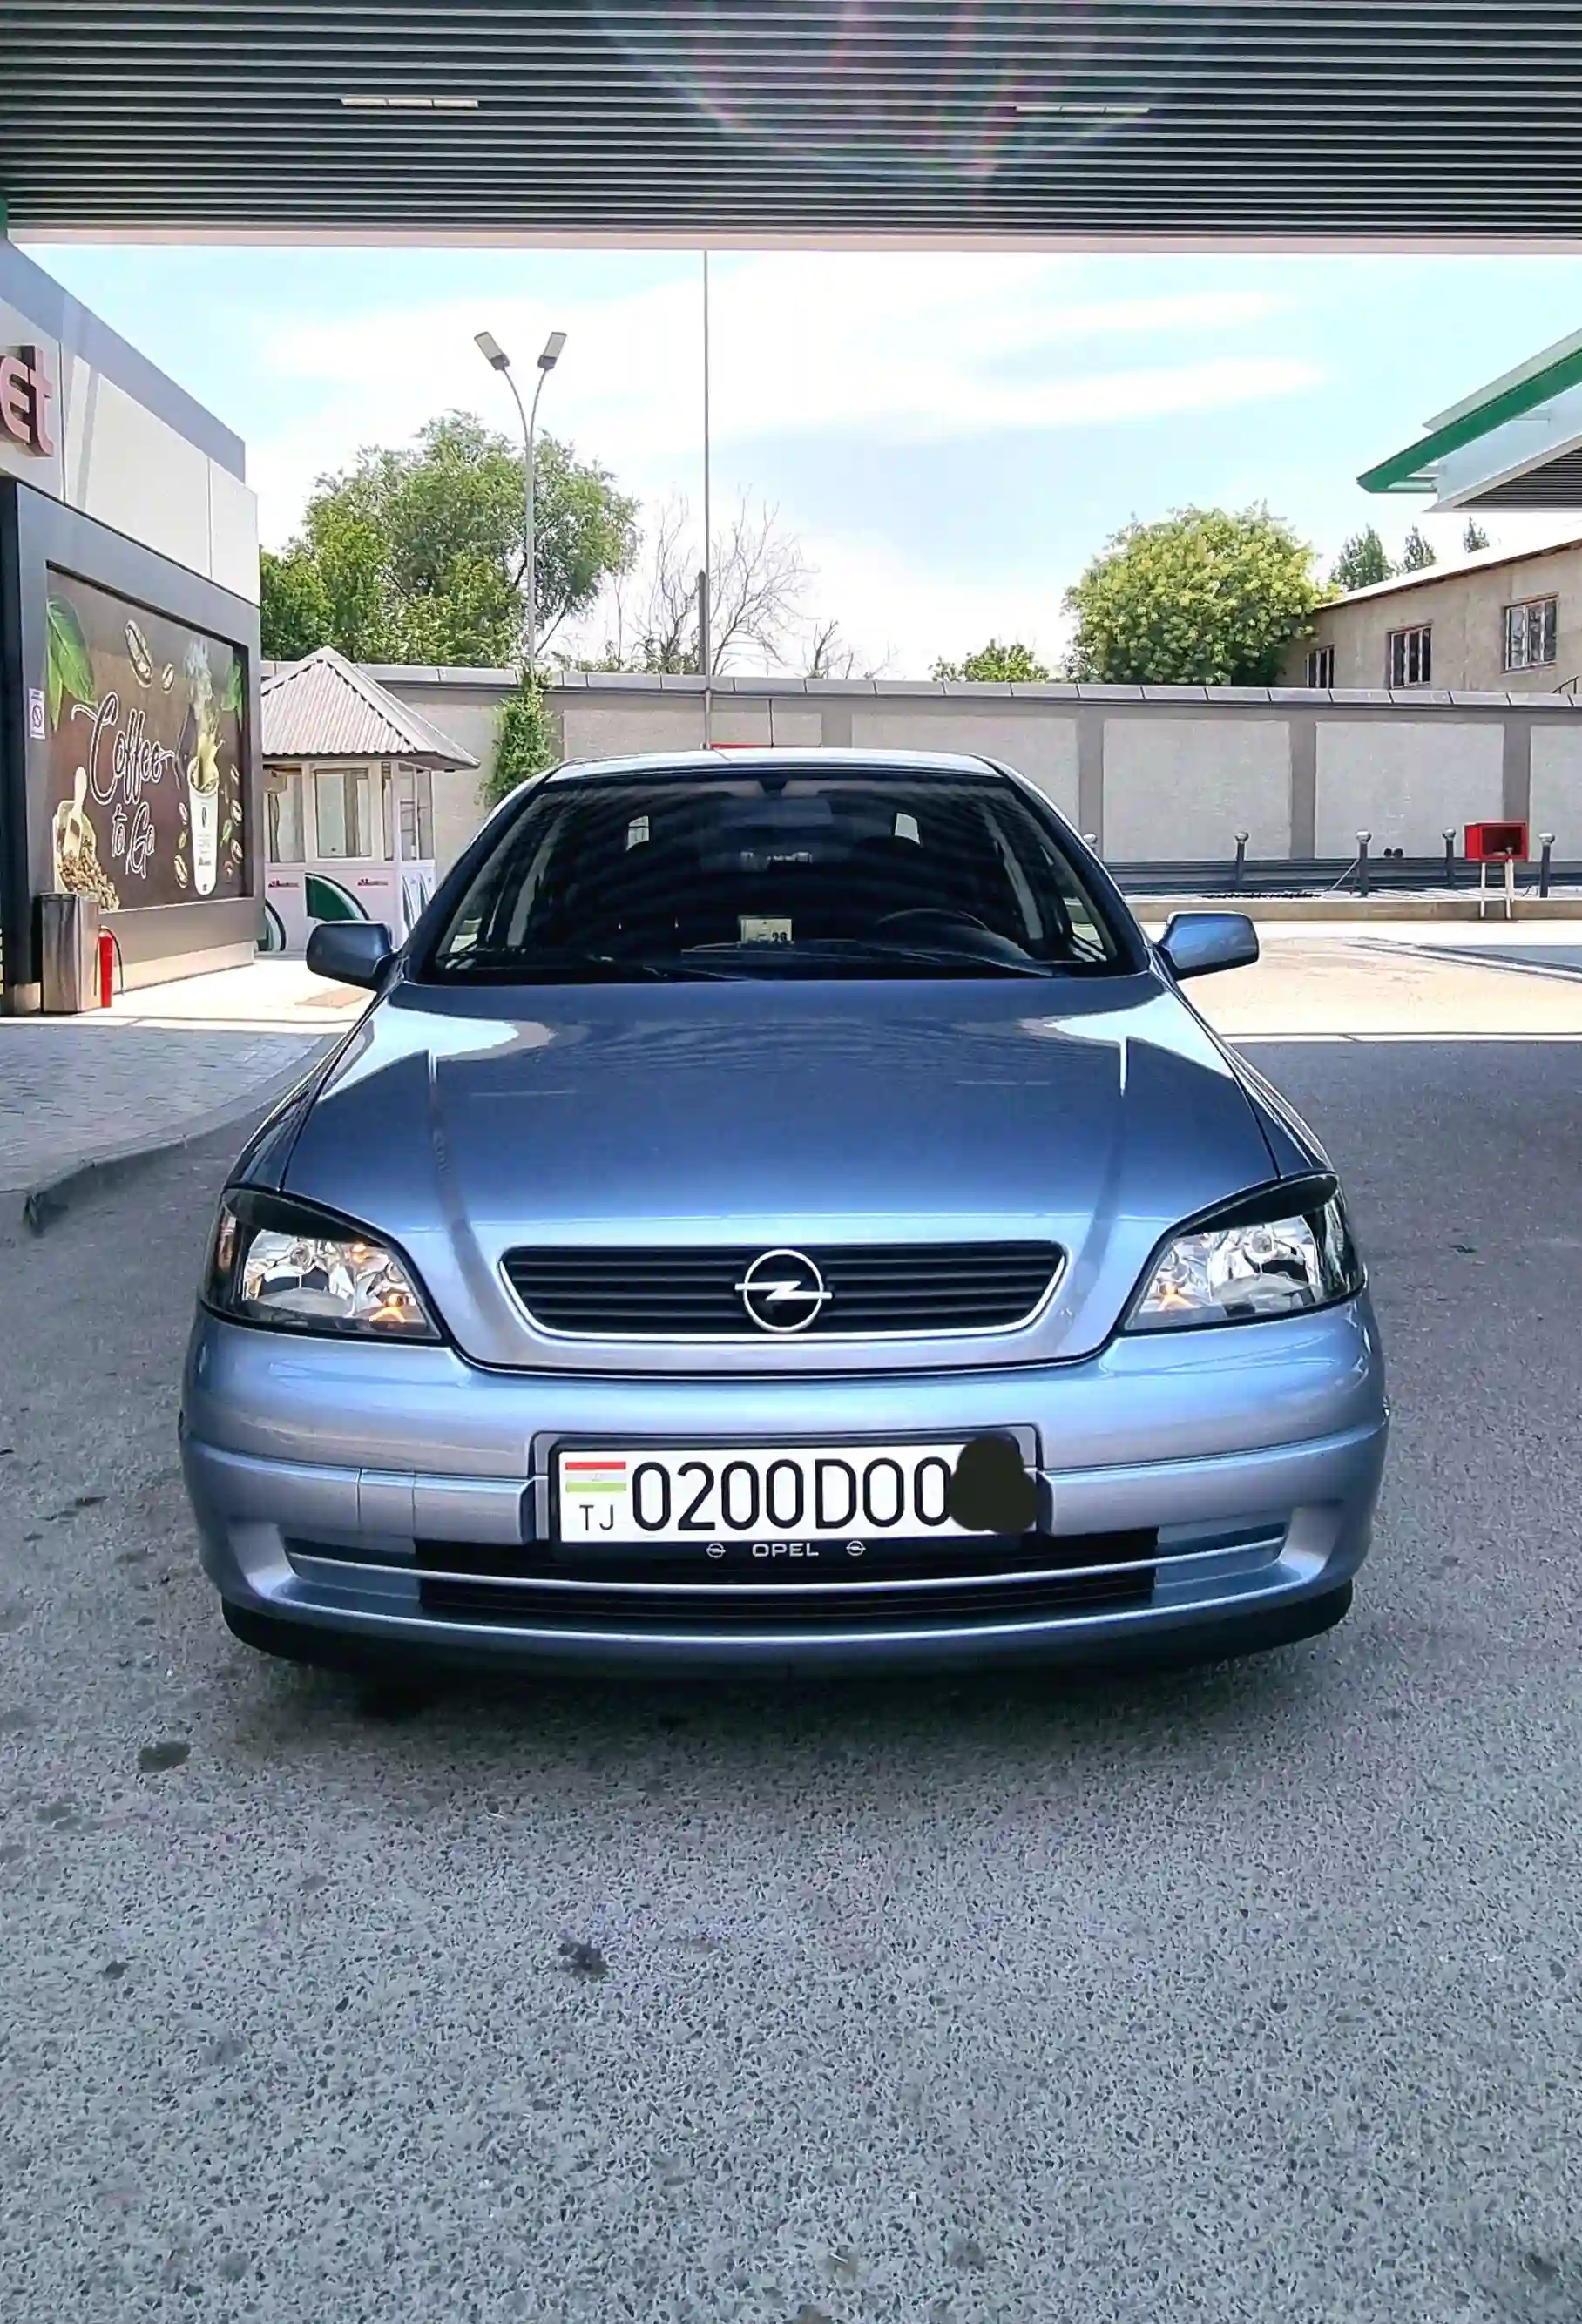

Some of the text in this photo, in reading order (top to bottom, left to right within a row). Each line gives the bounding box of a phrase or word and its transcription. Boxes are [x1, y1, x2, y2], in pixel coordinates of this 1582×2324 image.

[71, 692, 174, 806] Coffee
[111, 801, 156, 879] to Go
[579, 1504, 614, 1531] TJ
[632, 1456, 952, 1530] 0200DO0
[752, 1543, 819, 1557] OPEL
